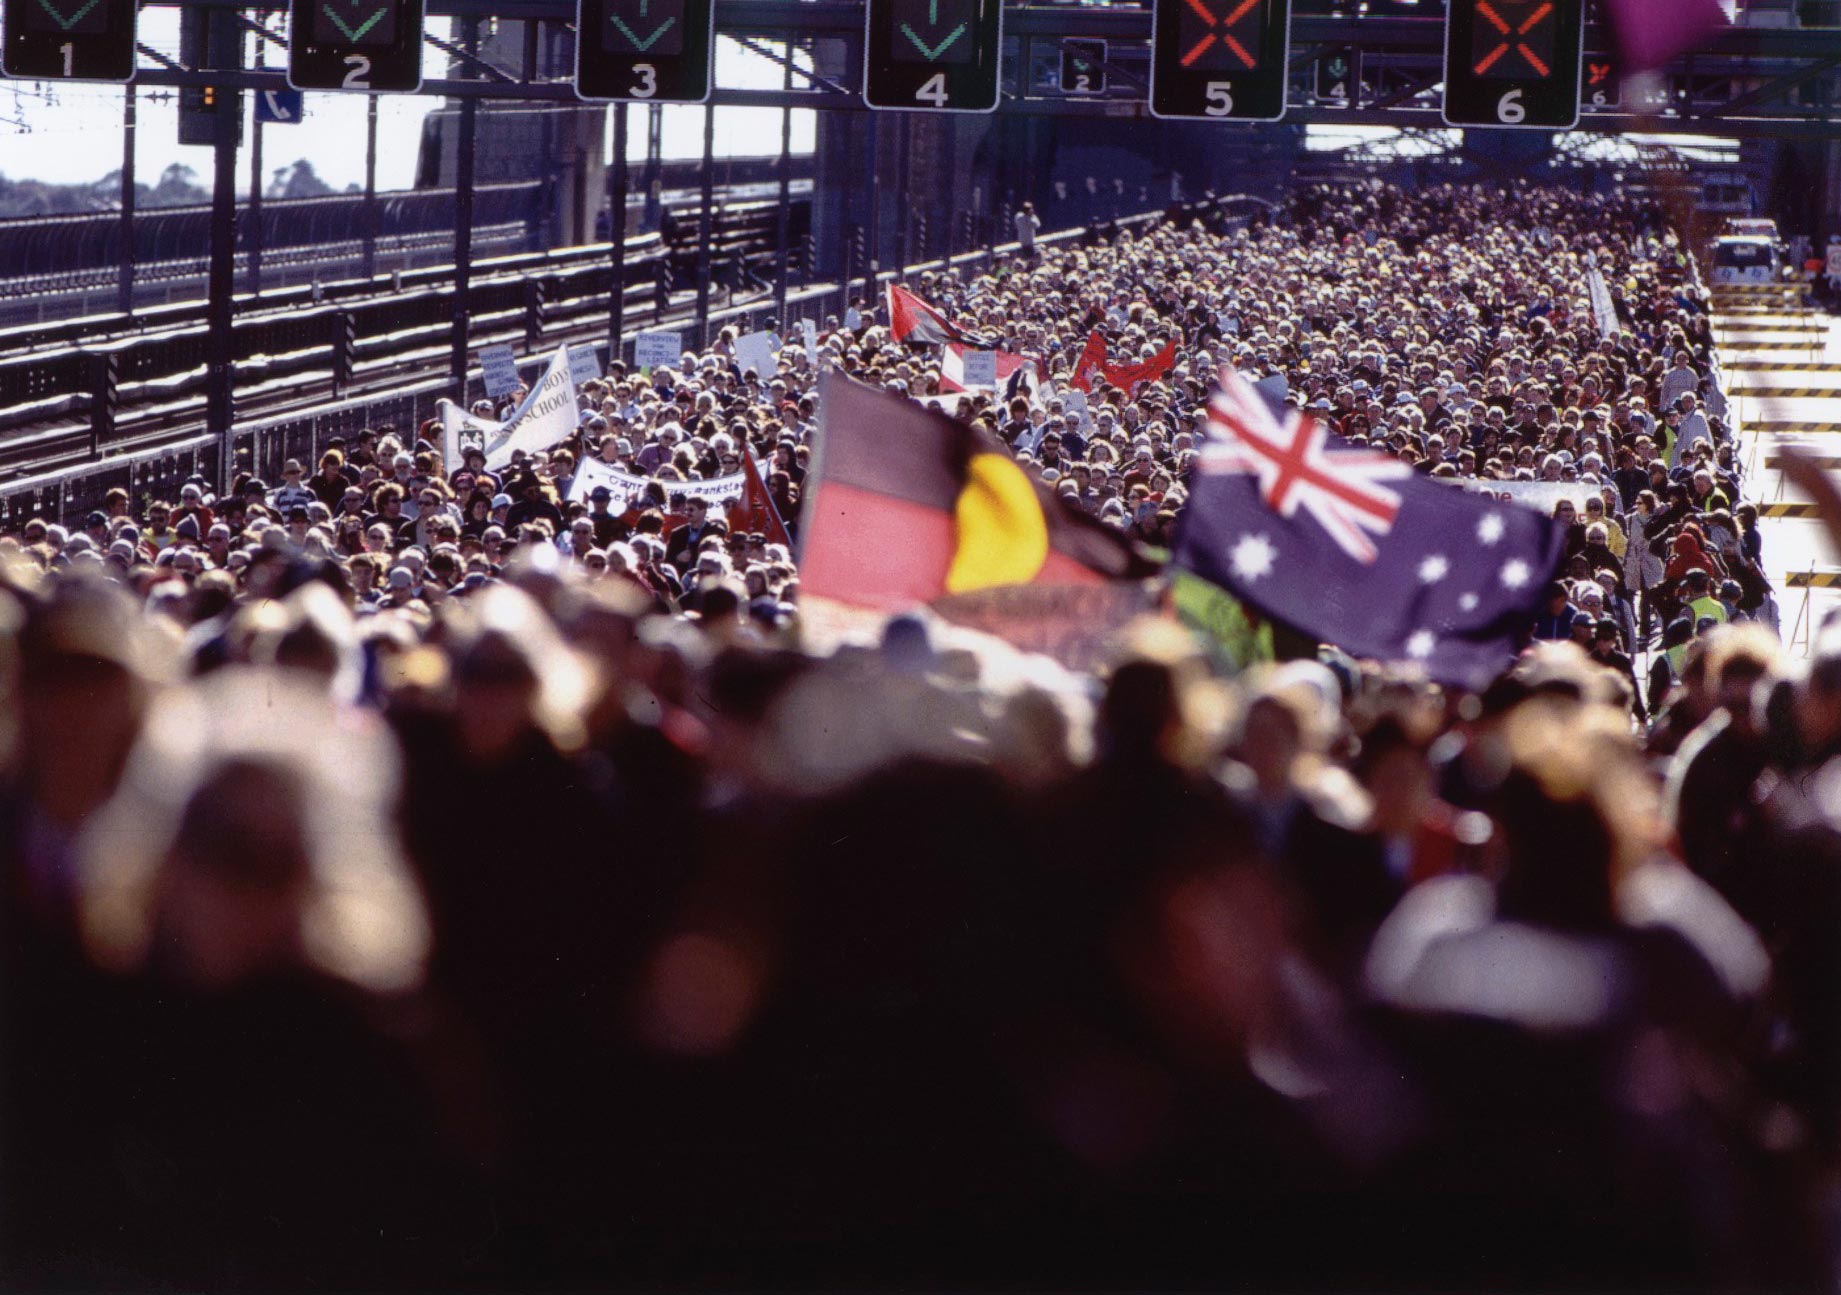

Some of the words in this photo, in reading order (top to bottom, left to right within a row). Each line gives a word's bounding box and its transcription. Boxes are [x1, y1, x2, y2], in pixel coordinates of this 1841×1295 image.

[60, 42, 73, 77] 1
[341, 54, 371, 89] 2
[629, 63, 657, 98] 3
[915, 73, 949, 107] 4
[1075, 75, 1090, 91] 2
[1330, 81, 1347, 99] 4
[1592, 90, 1606, 105] 6
[1205, 81, 1233, 116] 5
[1497, 88, 1526, 123] 6
